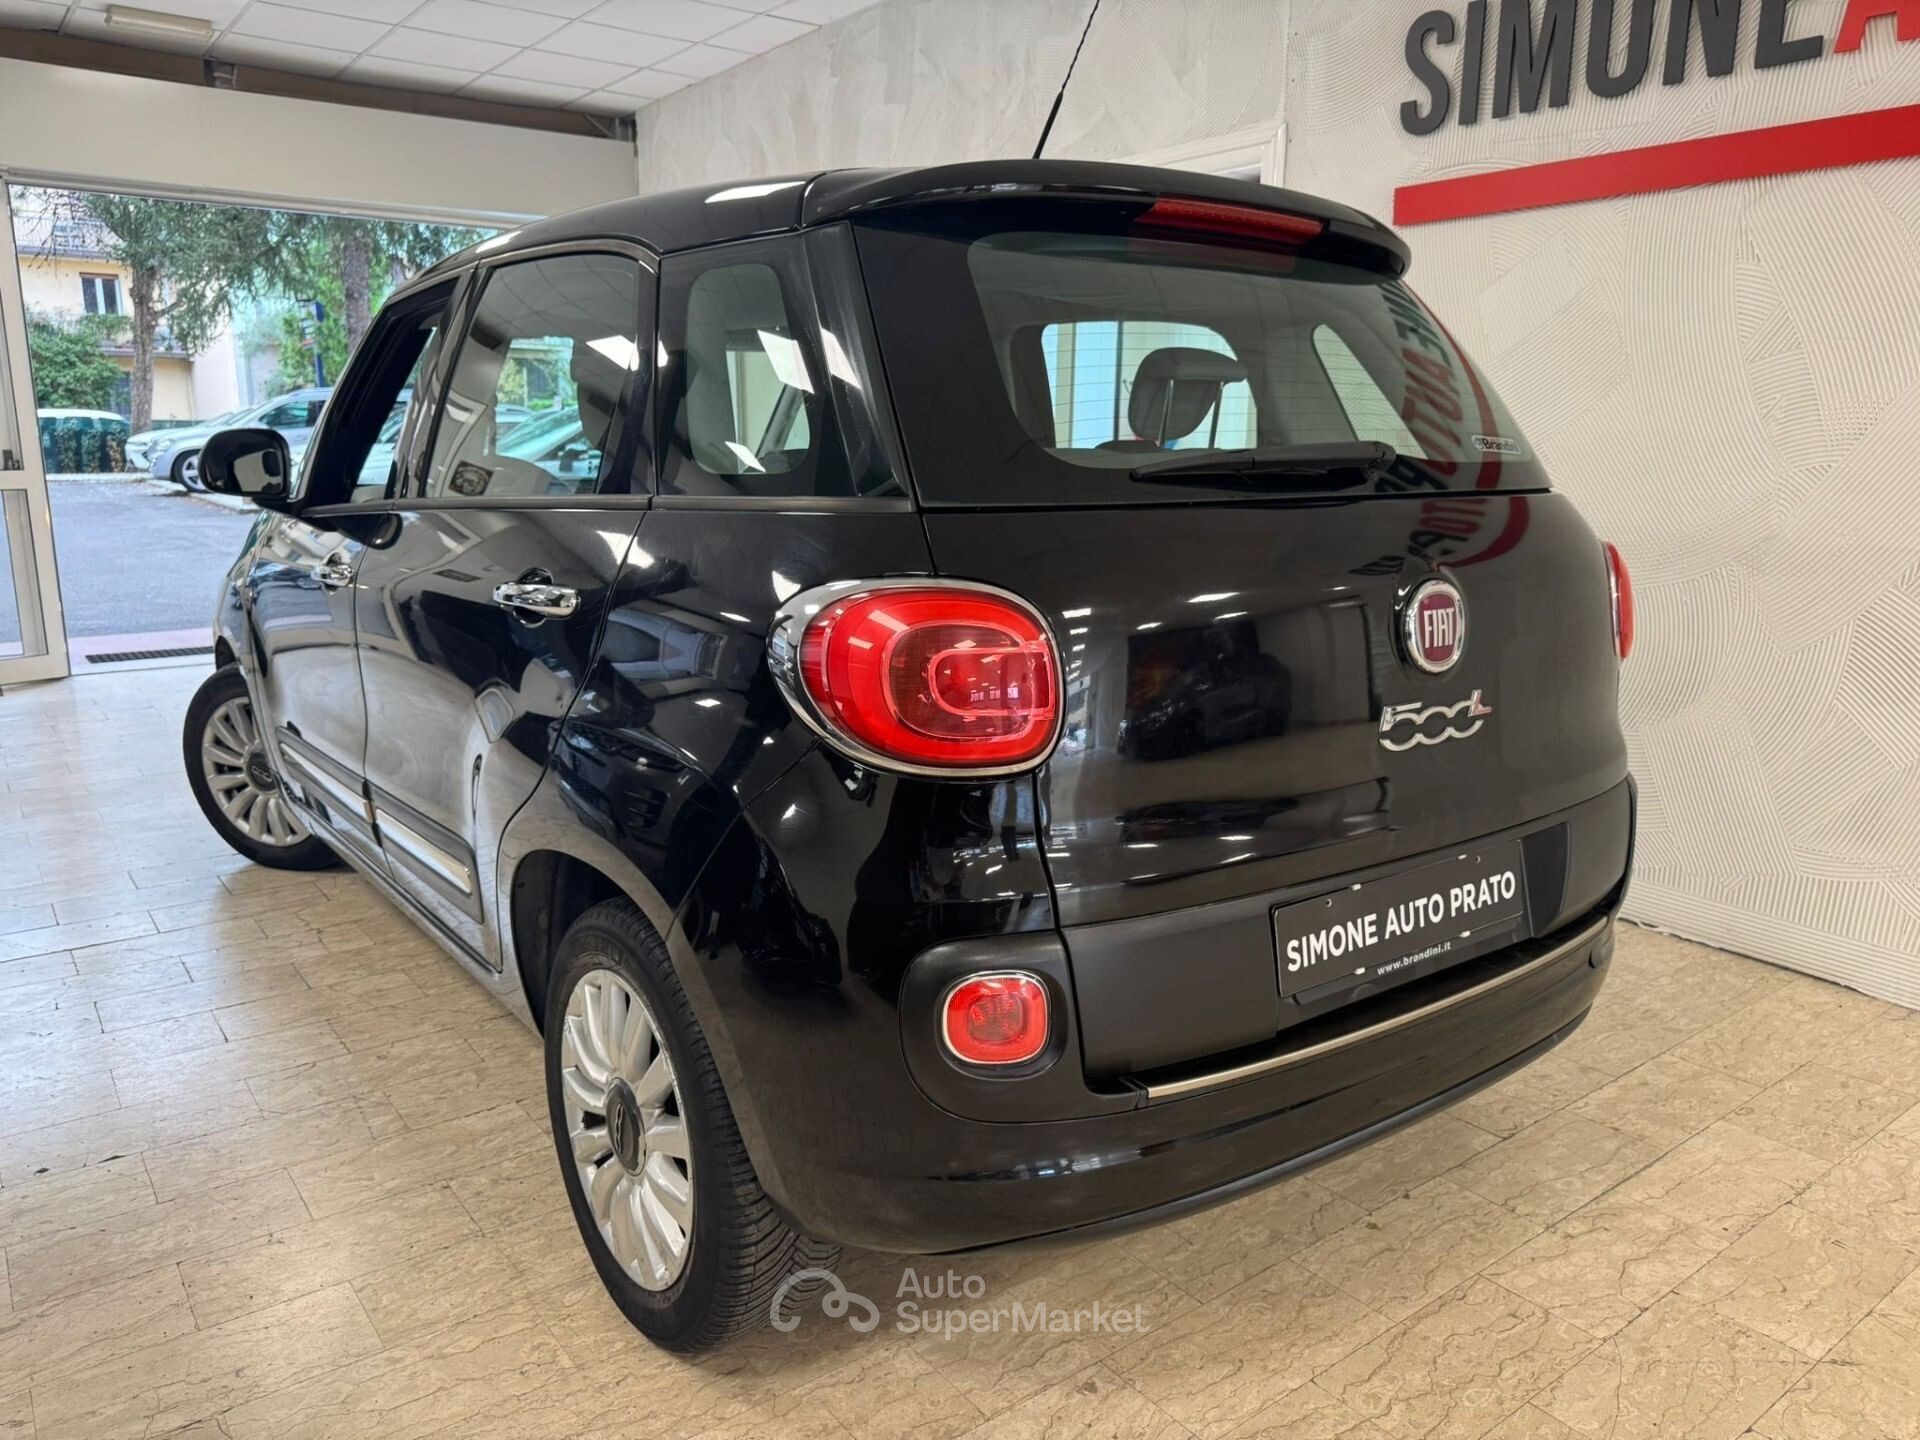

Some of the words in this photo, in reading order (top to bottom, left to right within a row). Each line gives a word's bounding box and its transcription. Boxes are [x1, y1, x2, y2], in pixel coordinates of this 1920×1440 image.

[1423, 607, 1455, 649] FIAT
[1287, 914, 1378, 971] SIMONE
[1385, 894, 1444, 939] AUTO
[1450, 871, 1515, 916] PRATO
[1377, 942, 1450, 975] www.brandini.it
